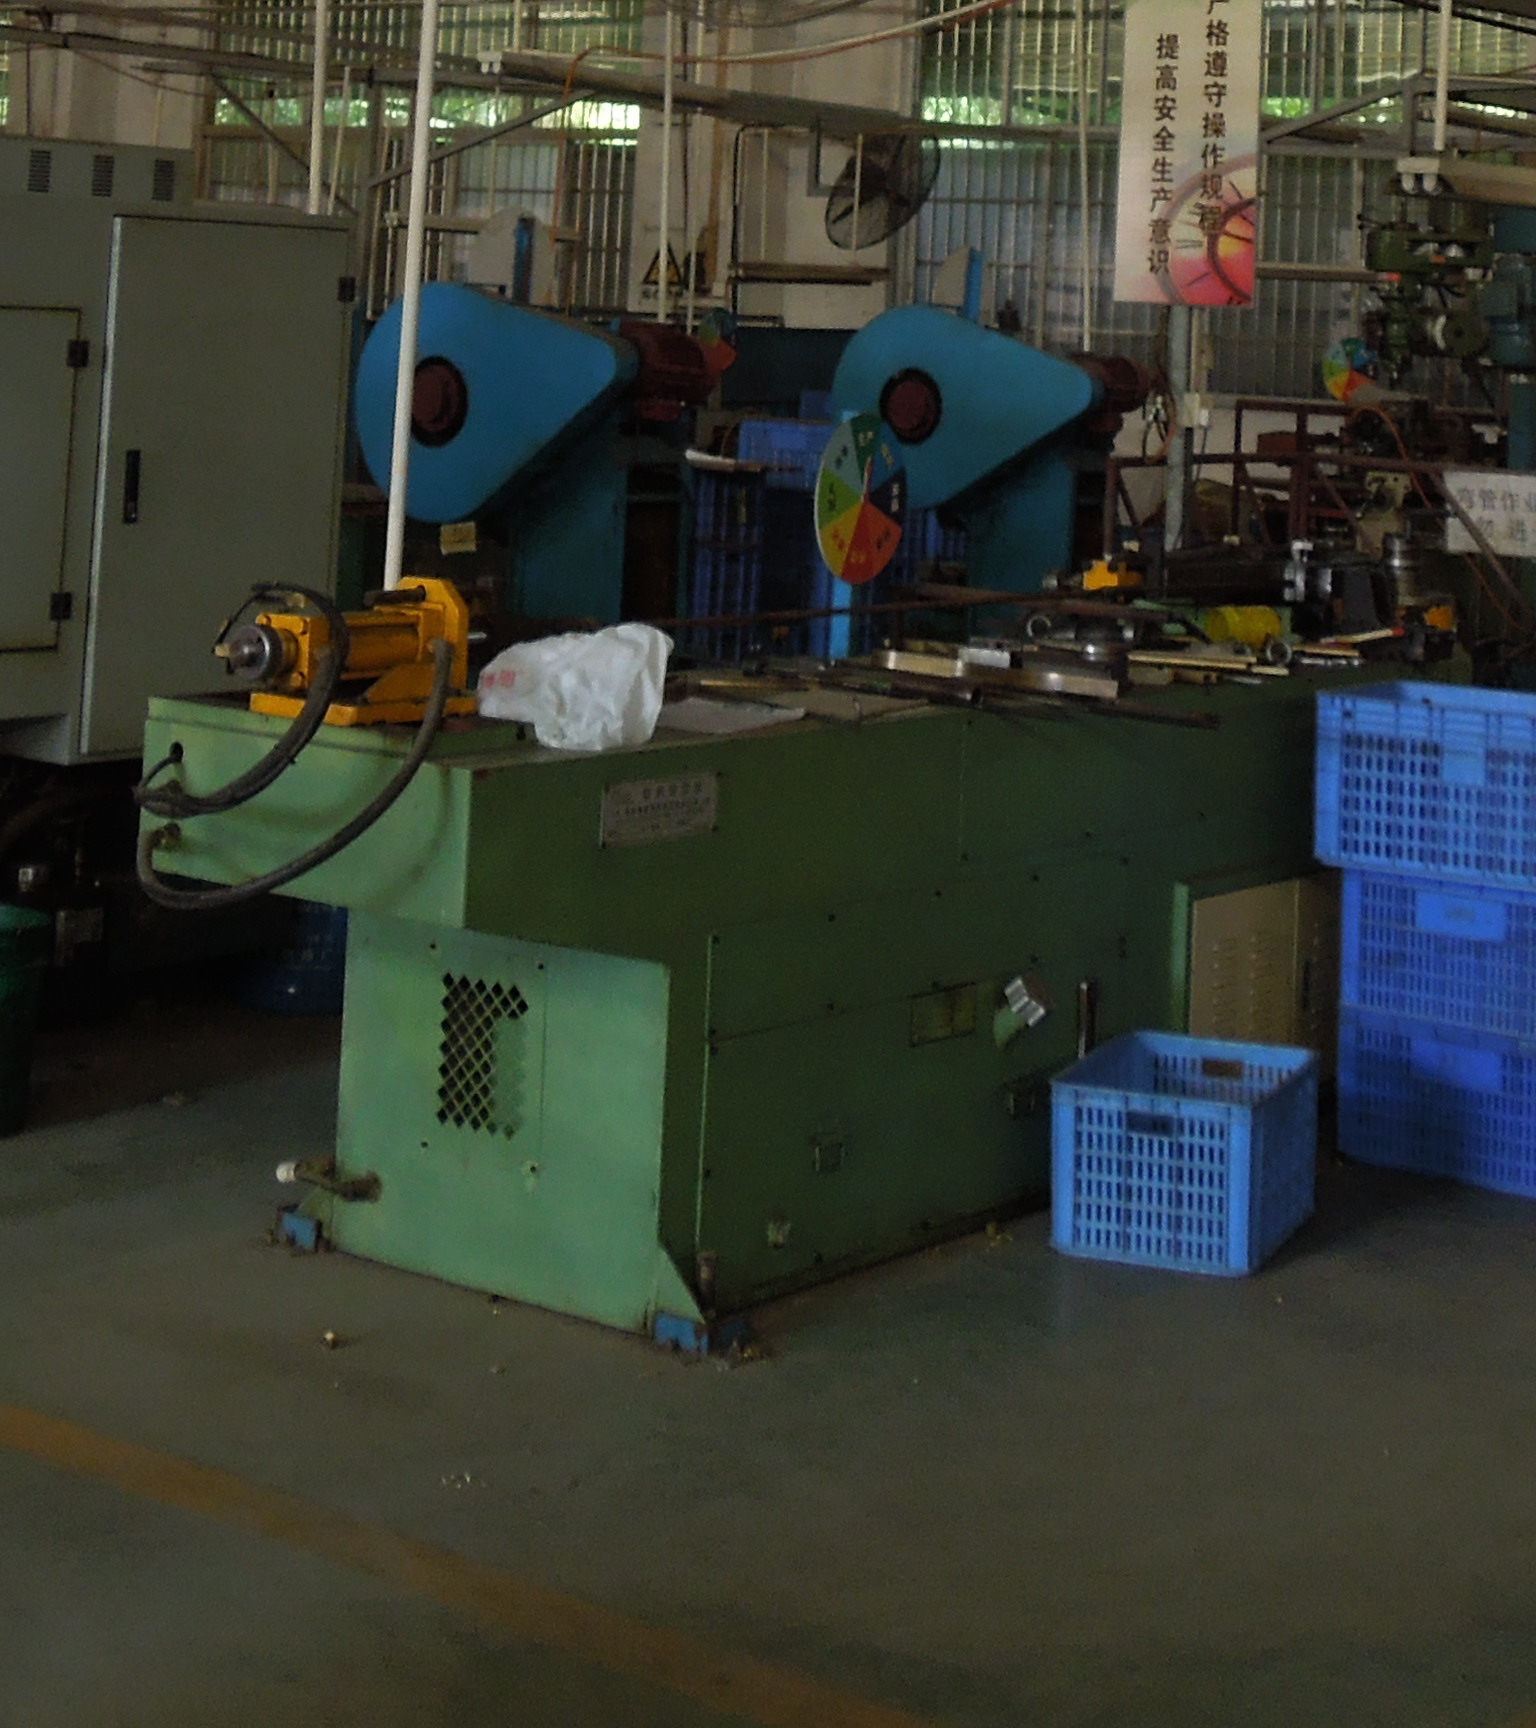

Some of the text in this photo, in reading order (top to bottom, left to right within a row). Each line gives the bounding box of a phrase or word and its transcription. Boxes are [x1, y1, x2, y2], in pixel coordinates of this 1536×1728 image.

[1147, 33, 1180, 275] 提高安全生产意识
